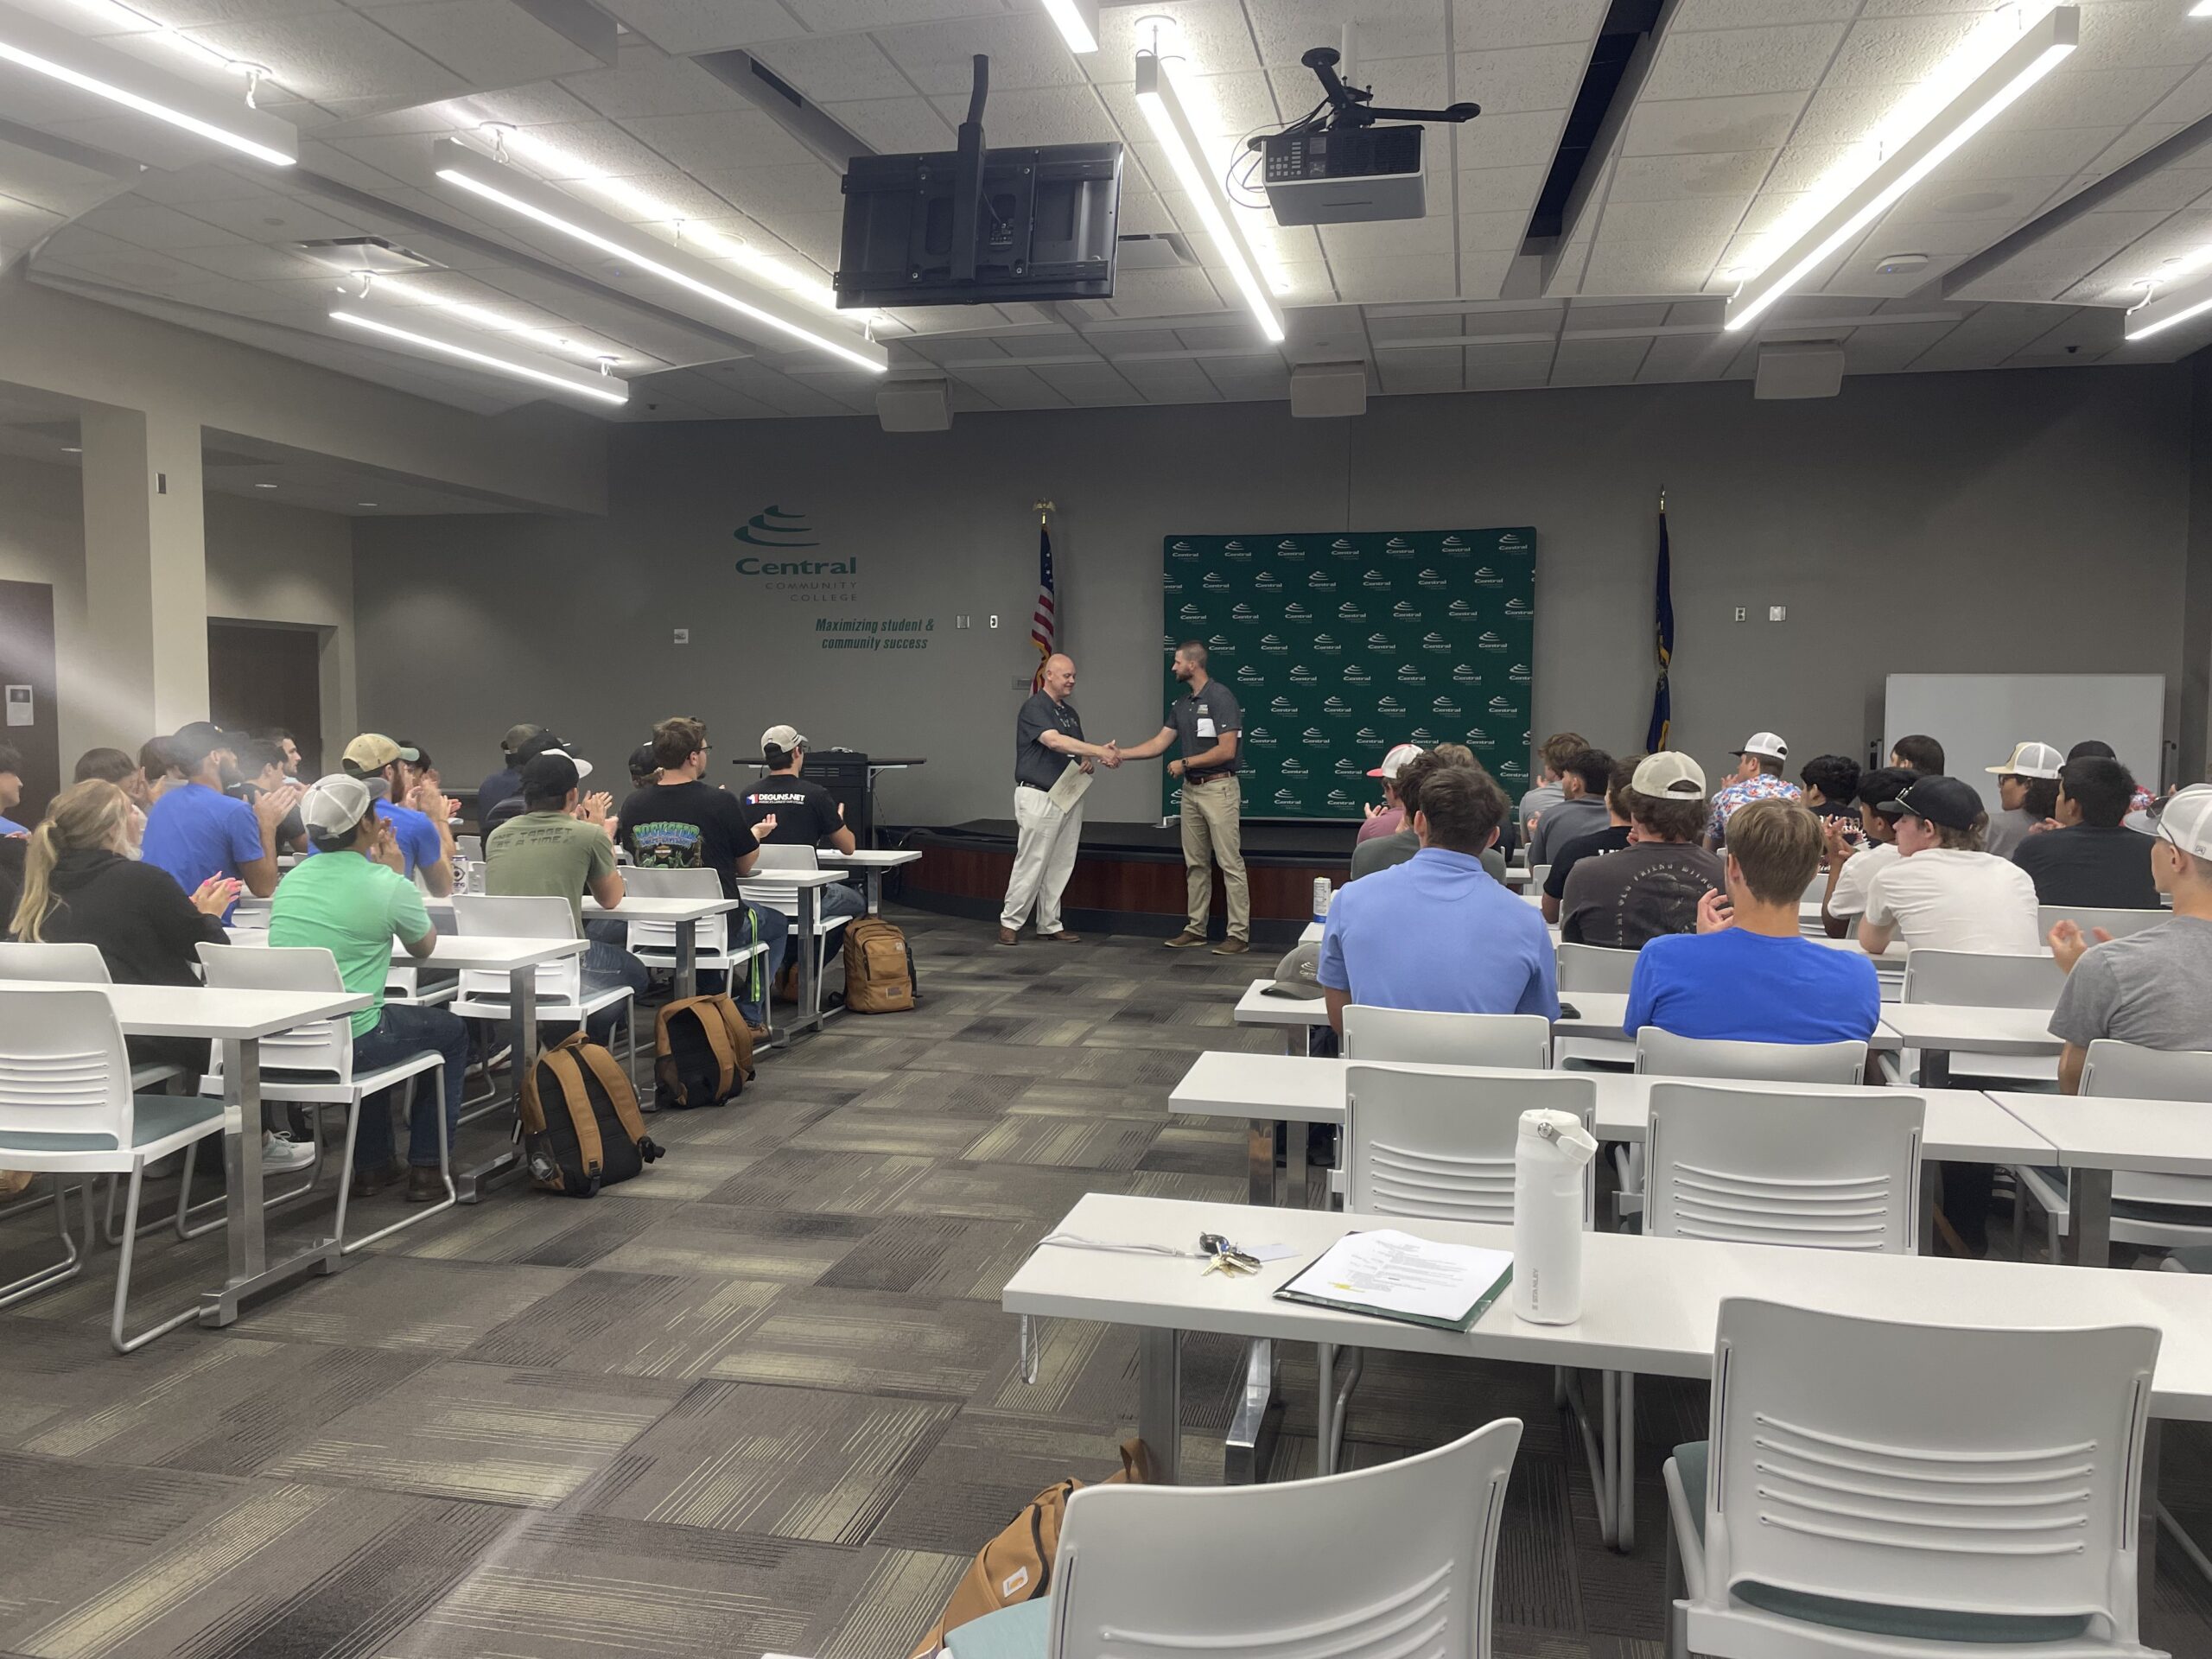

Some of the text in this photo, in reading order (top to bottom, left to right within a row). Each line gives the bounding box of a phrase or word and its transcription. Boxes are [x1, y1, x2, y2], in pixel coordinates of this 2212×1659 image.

[735, 557, 856, 575] Central
[816, 618, 935, 633] Maximizing student &
[822, 637, 928, 651] community success
[759, 793, 805, 802] DEGUNS.NET
[520, 827, 573, 839] TARGET
